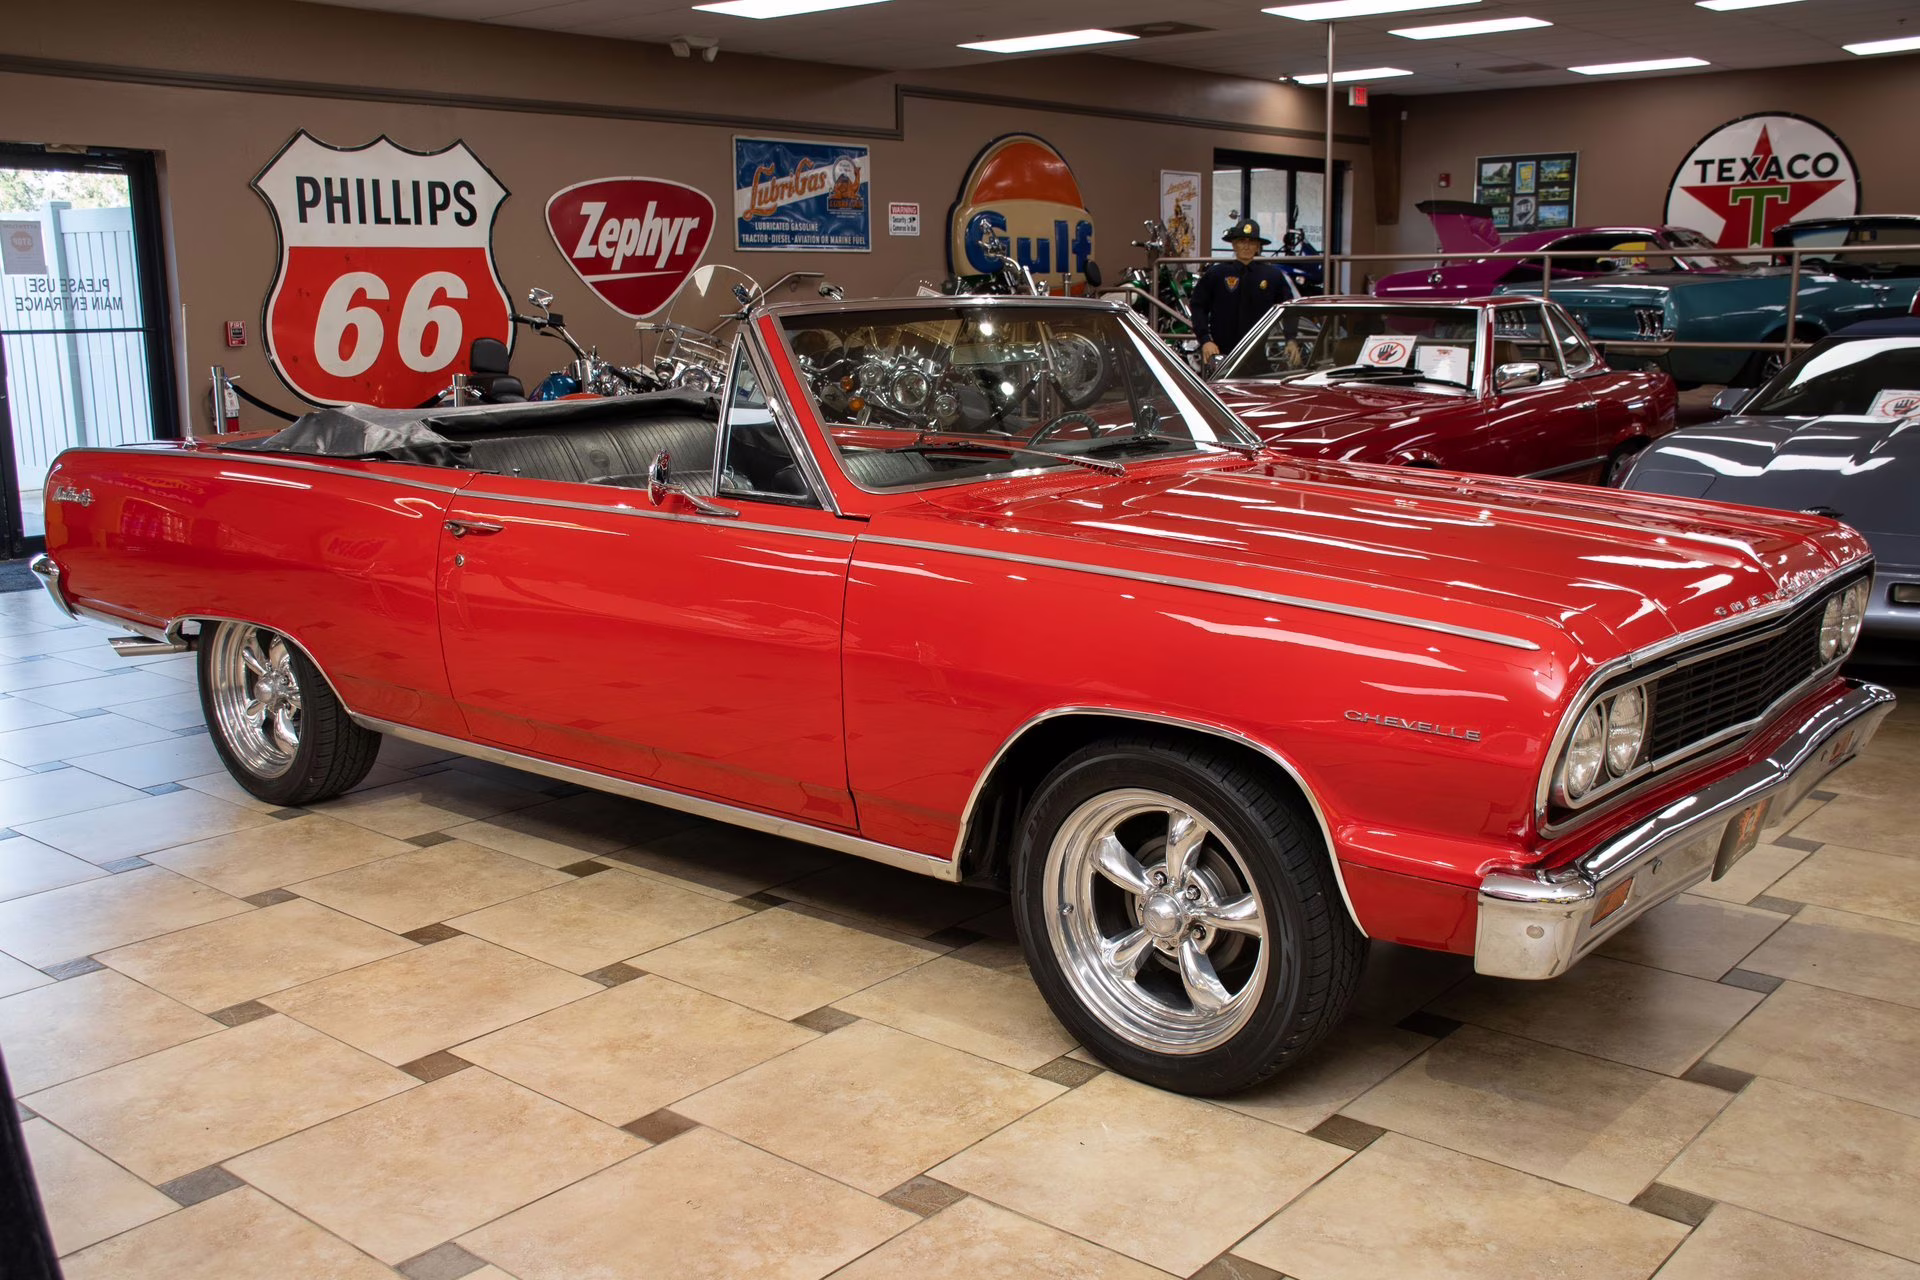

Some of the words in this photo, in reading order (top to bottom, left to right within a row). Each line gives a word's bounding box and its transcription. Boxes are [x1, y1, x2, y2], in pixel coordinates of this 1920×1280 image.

[1694, 152, 1839, 183] TEXACO
[295, 176, 478, 227] PHILLIPS
[891, 206, 917, 214] WARNING
[1729, 185, 1790, 249] T
[572, 201, 700, 270] Zephyr
[754, 221, 790, 231] LUBRICATED
[791, 222, 818, 232] GASOLINE
[892, 216, 906, 224] Security
[892, 224, 906, 232] Cameras
[742, 234, 769, 243] TRACTOR
[771, 234, 792, 244] DIESEL
[795, 235, 820, 245] AVIATION
[820, 235, 829, 245] OR
[830, 235, 851, 245] MARINE
[852, 236, 866, 245] FUEL
[965, 210, 1093, 274] Gulf
[314, 271, 468, 377] 66
[1344, 710, 1481, 742] CHEVELLE
